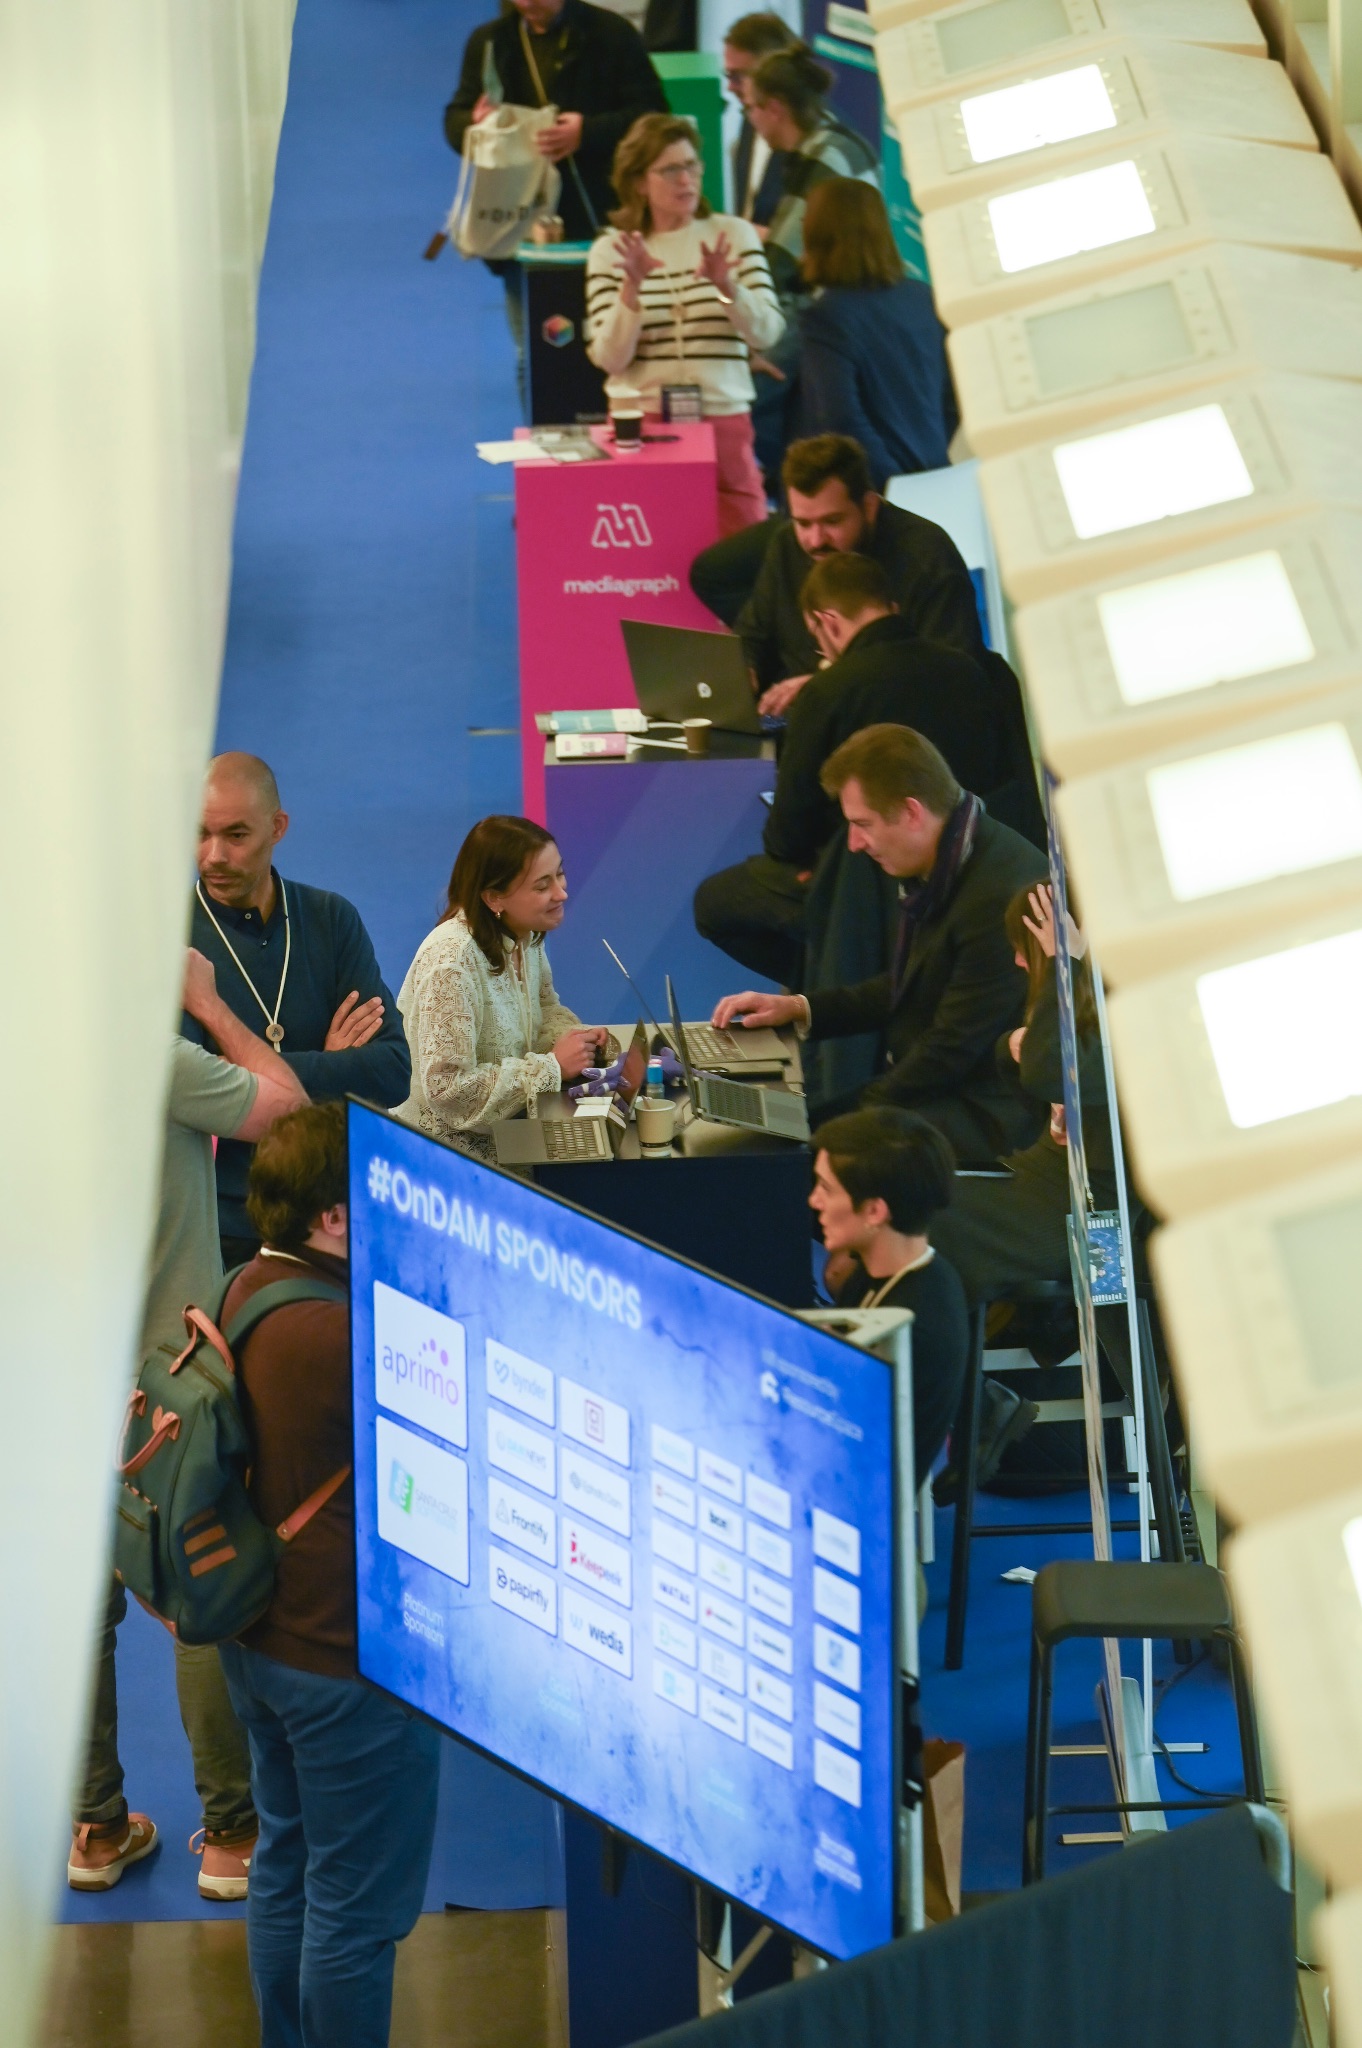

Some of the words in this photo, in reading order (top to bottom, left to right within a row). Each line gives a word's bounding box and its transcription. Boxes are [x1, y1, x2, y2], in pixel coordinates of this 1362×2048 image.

[563, 575, 680, 598] mediagraph
[368, 1156, 492, 1256] #OnDAM
[496, 1221, 643, 1331] SPONSORS
[382, 1345, 460, 1406] aprimo
[511, 1367, 547, 1400] bynder
[511, 1509, 549, 1545] Frontify
[403, 1591, 445, 1627] Platinum
[509, 1576, 549, 1613] papirfly
[402, 1611, 445, 1649] Sponsors
[588, 1622, 625, 1656] wedia
